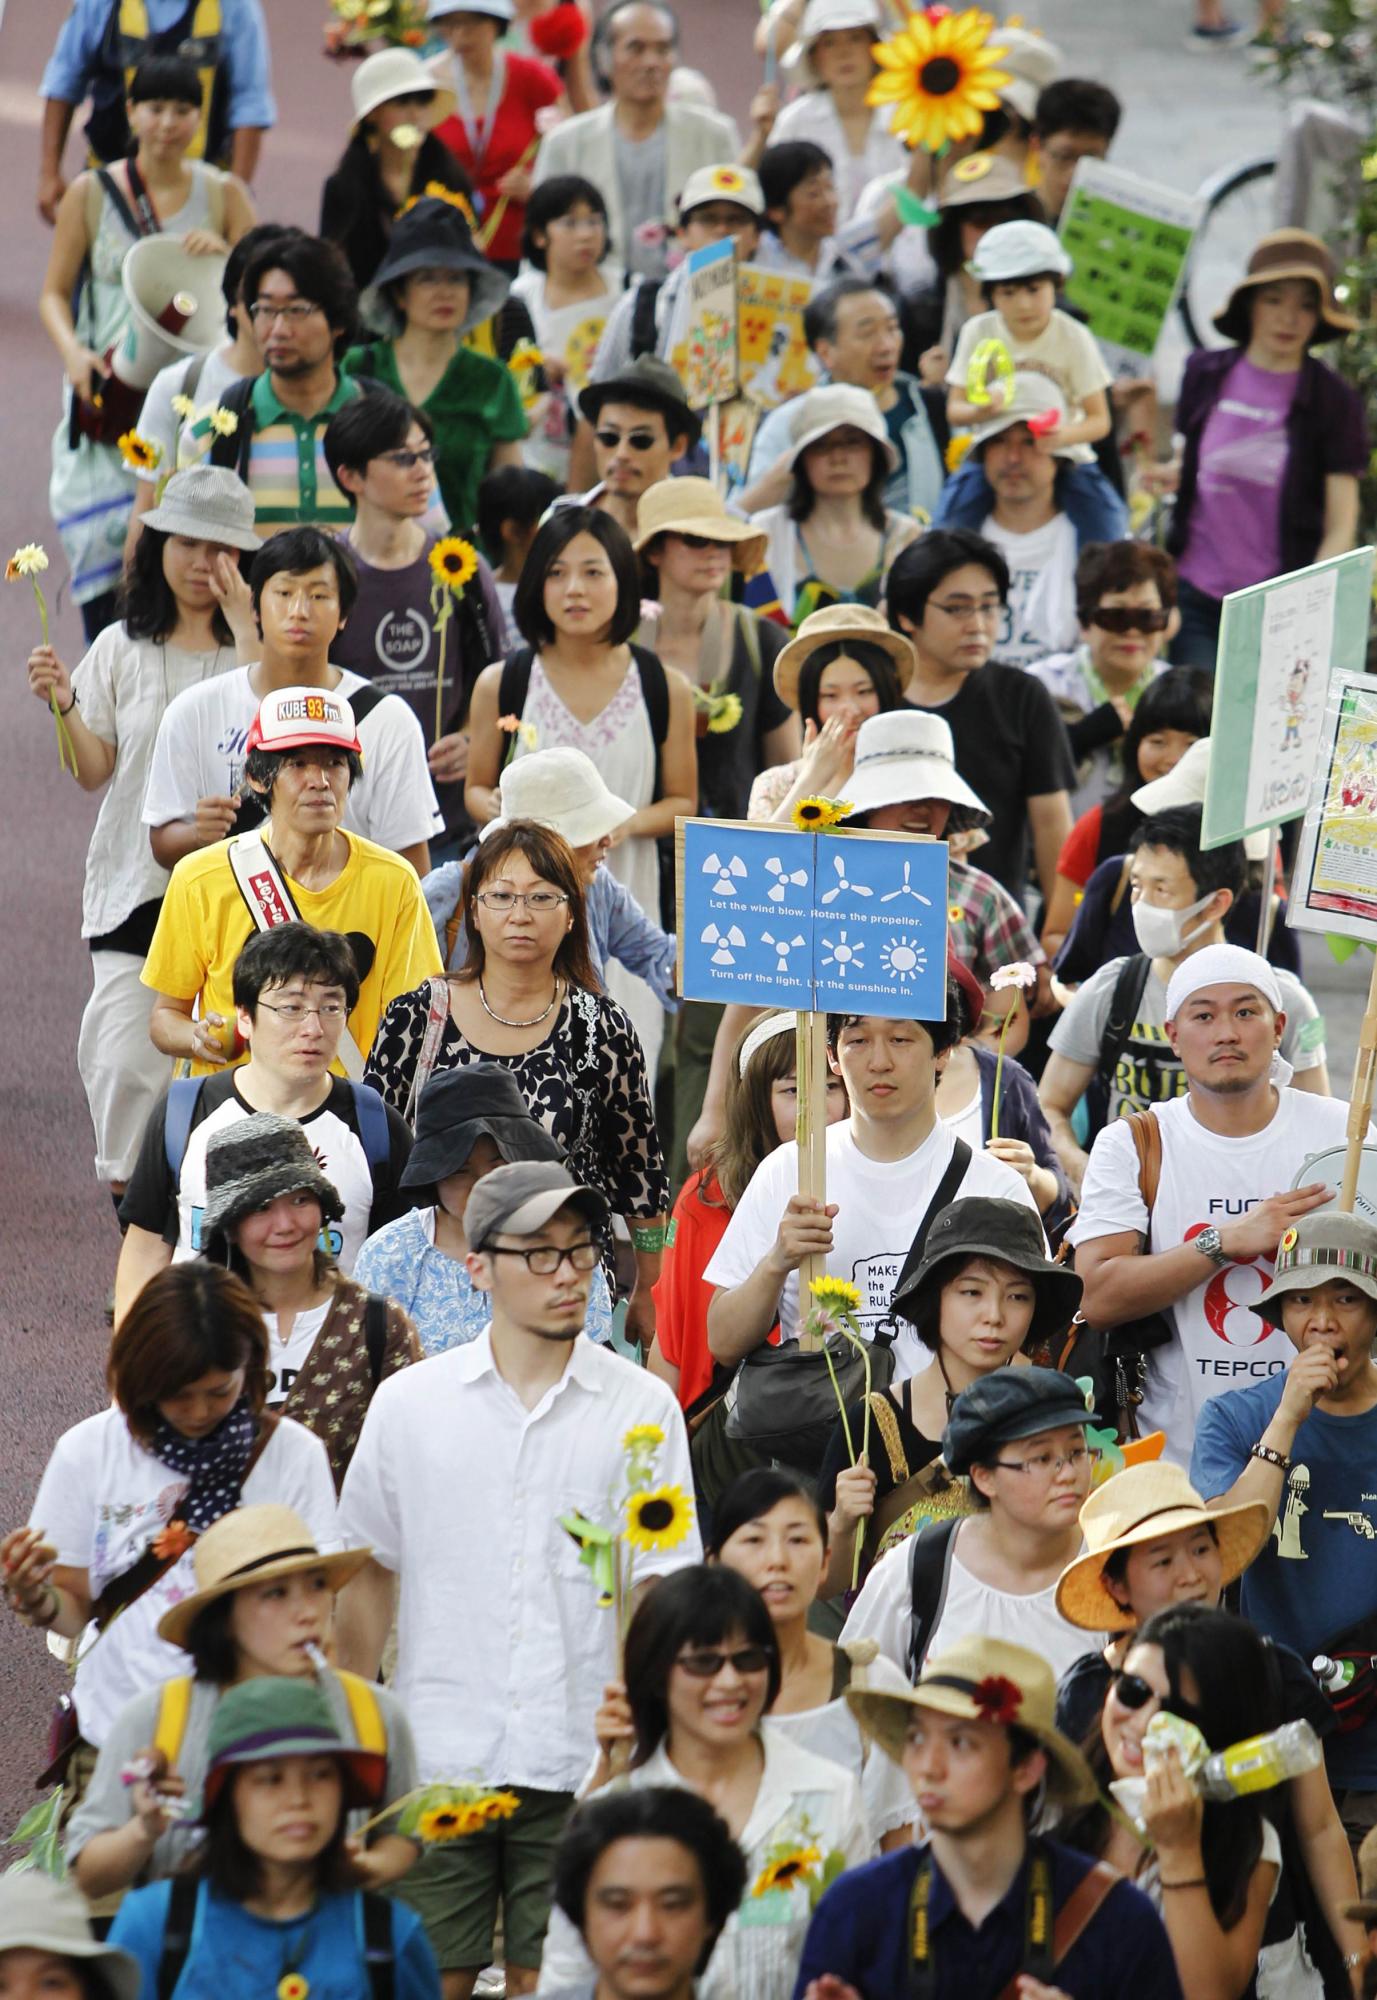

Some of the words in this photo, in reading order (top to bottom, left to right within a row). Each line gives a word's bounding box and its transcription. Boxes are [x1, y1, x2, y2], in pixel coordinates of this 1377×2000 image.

[388, 622, 416, 637] THE
[385, 638, 422, 655] SOAP
[279, 701, 307, 721] KUBE
[307, 698, 323, 719] 93
[709, 899, 727, 909] Let
[730, 902, 747, 911] the
[750, 904, 775, 914] wind
[778, 906, 806, 917] blow.
[810, 909, 847, 920] Rotate
[850, 912, 867, 922] the
[870, 914, 922, 927] propeller.
[710, 968, 734, 979] Turn
[737, 972, 752, 981] off
[755, 973, 773, 983] the
[776, 975, 803, 987] light.
[807, 978, 824, 989] Let
[827, 980, 844, 990] the
[848, 983, 897, 995] sunshine
[900, 986, 913, 996] in.
[867, 1265, 898, 1277] MAKE
[868, 1281, 885, 1291] the
[1196, 1358, 1286, 1377] TEPCO
